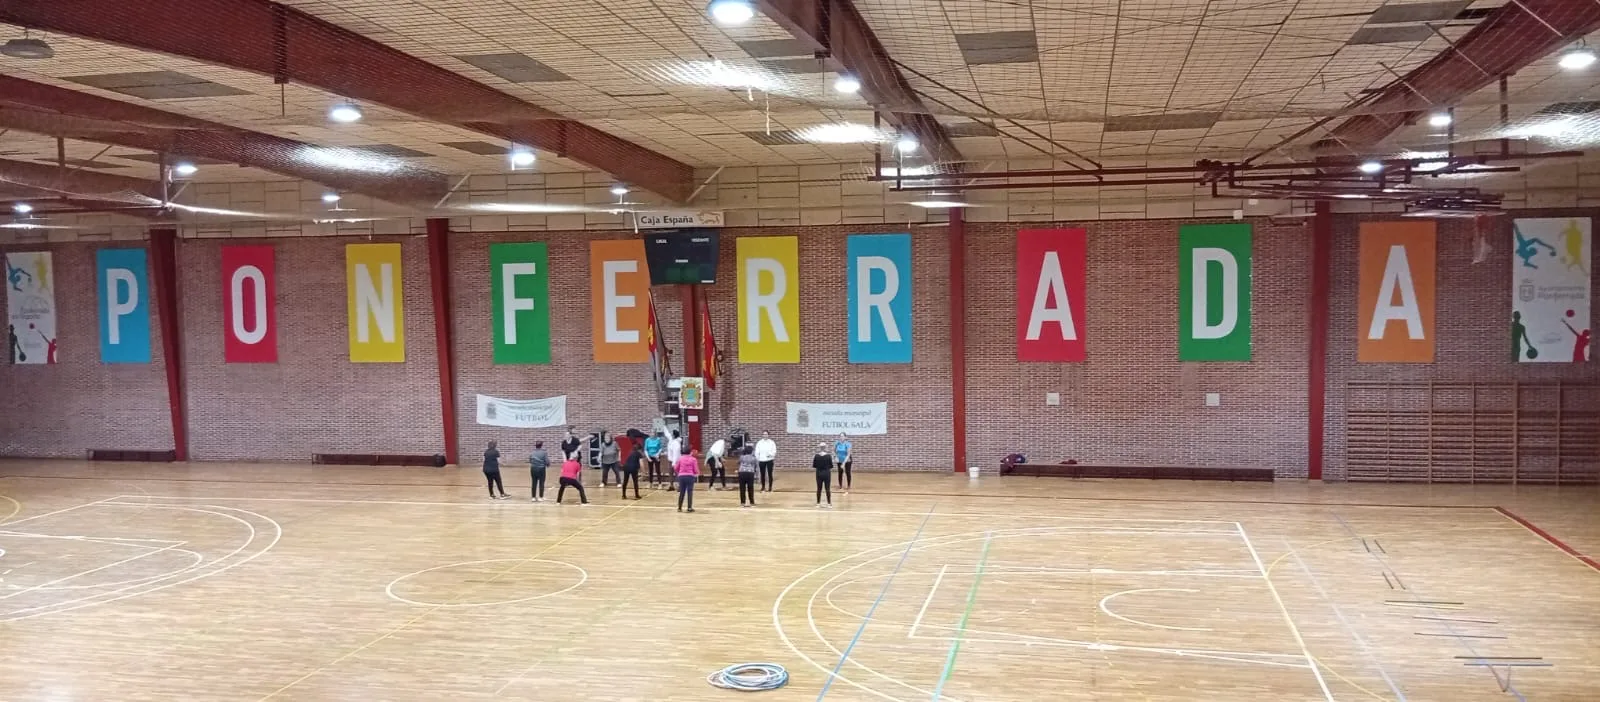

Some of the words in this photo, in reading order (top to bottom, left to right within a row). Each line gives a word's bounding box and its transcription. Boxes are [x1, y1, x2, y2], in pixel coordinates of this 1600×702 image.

[641, 216, 660, 225] Caja
[663, 215, 694, 226] España
[107, 268, 138, 344] P
[231, 265, 267, 344] O
[355, 263, 395, 343] N
[502, 262, 536, 344] F
[603, 260, 640, 343] E
[746, 257, 789, 343] R
[857, 256, 902, 342] R
[1026, 251, 1077, 341] A
[1191, 247, 1239, 339] D
[1368, 244, 1425, 340] A
[851, 421, 872, 429] SALA
